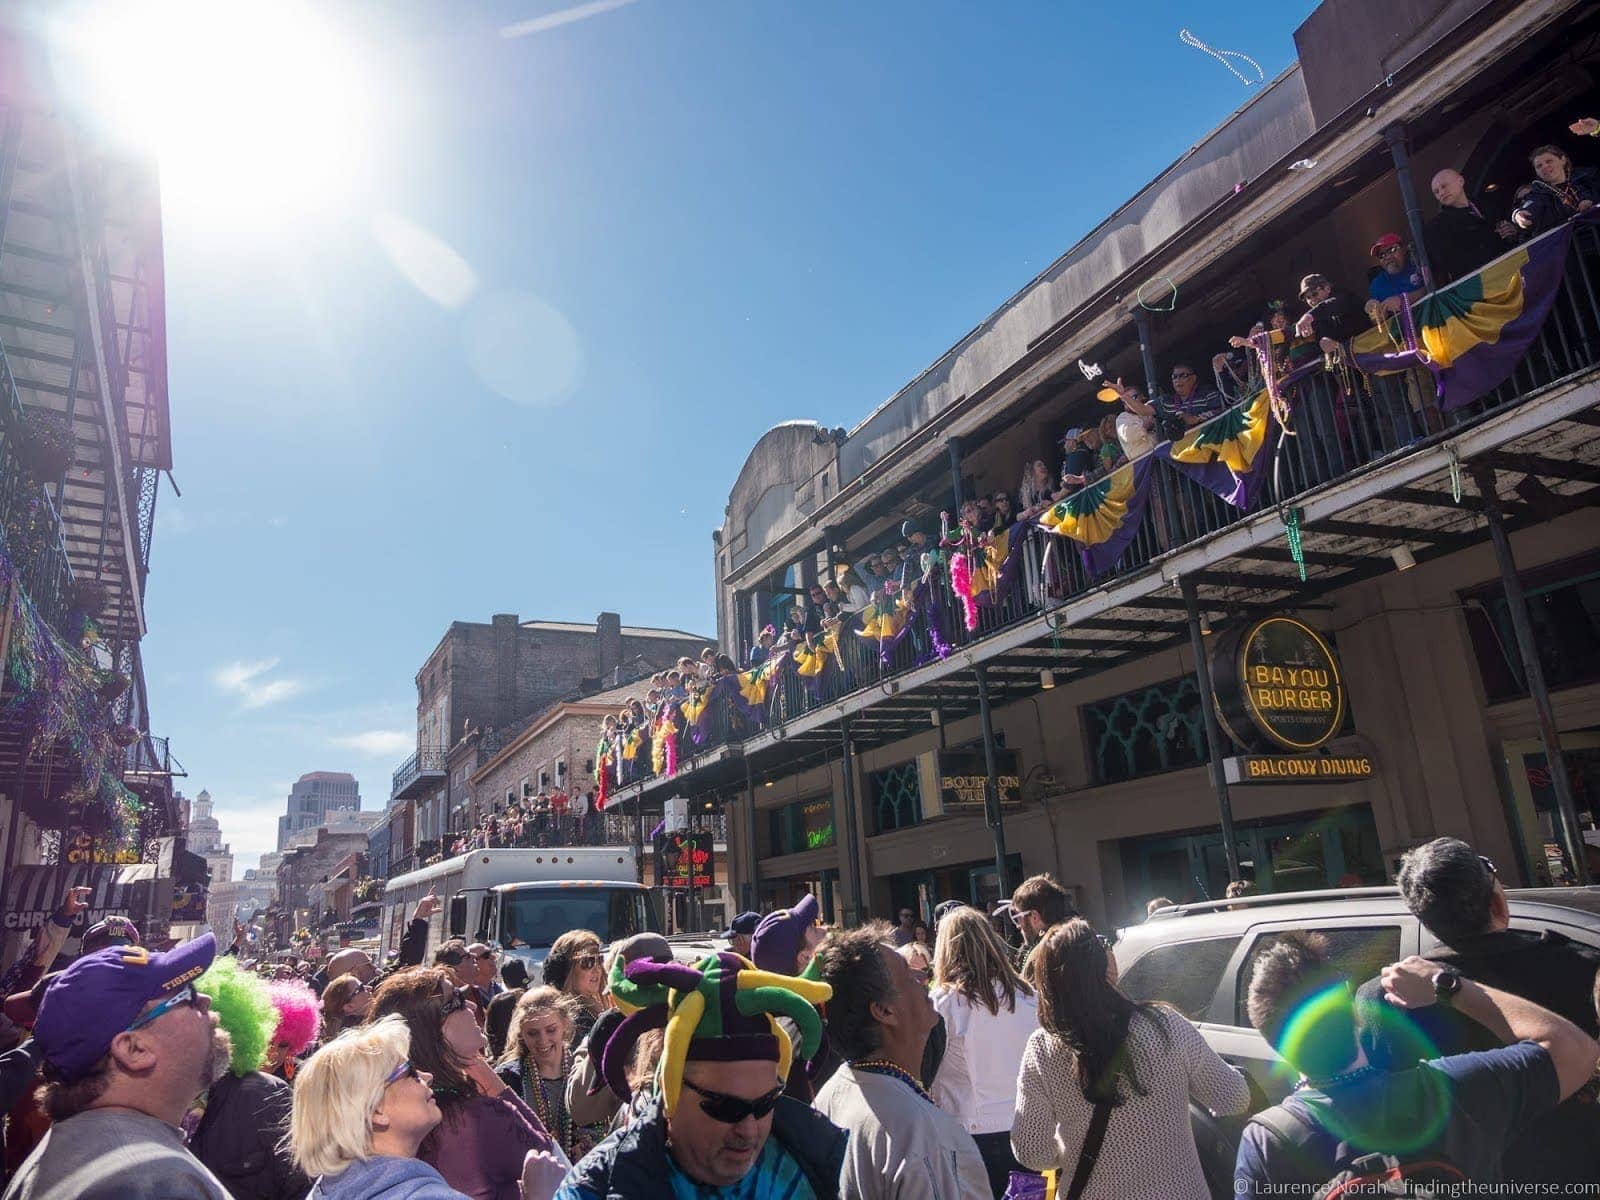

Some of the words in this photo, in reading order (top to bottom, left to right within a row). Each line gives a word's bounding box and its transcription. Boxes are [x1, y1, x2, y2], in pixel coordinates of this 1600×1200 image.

[1255, 665, 1328, 687] BAYOU
[1259, 689, 1332, 708] BURGER
[1250, 760, 1316, 776] BALCONY
[1321, 758, 1371, 775] DINING
[943, 776, 1019, 790] BOURON
[162, 965, 203, 991] TIGERS
